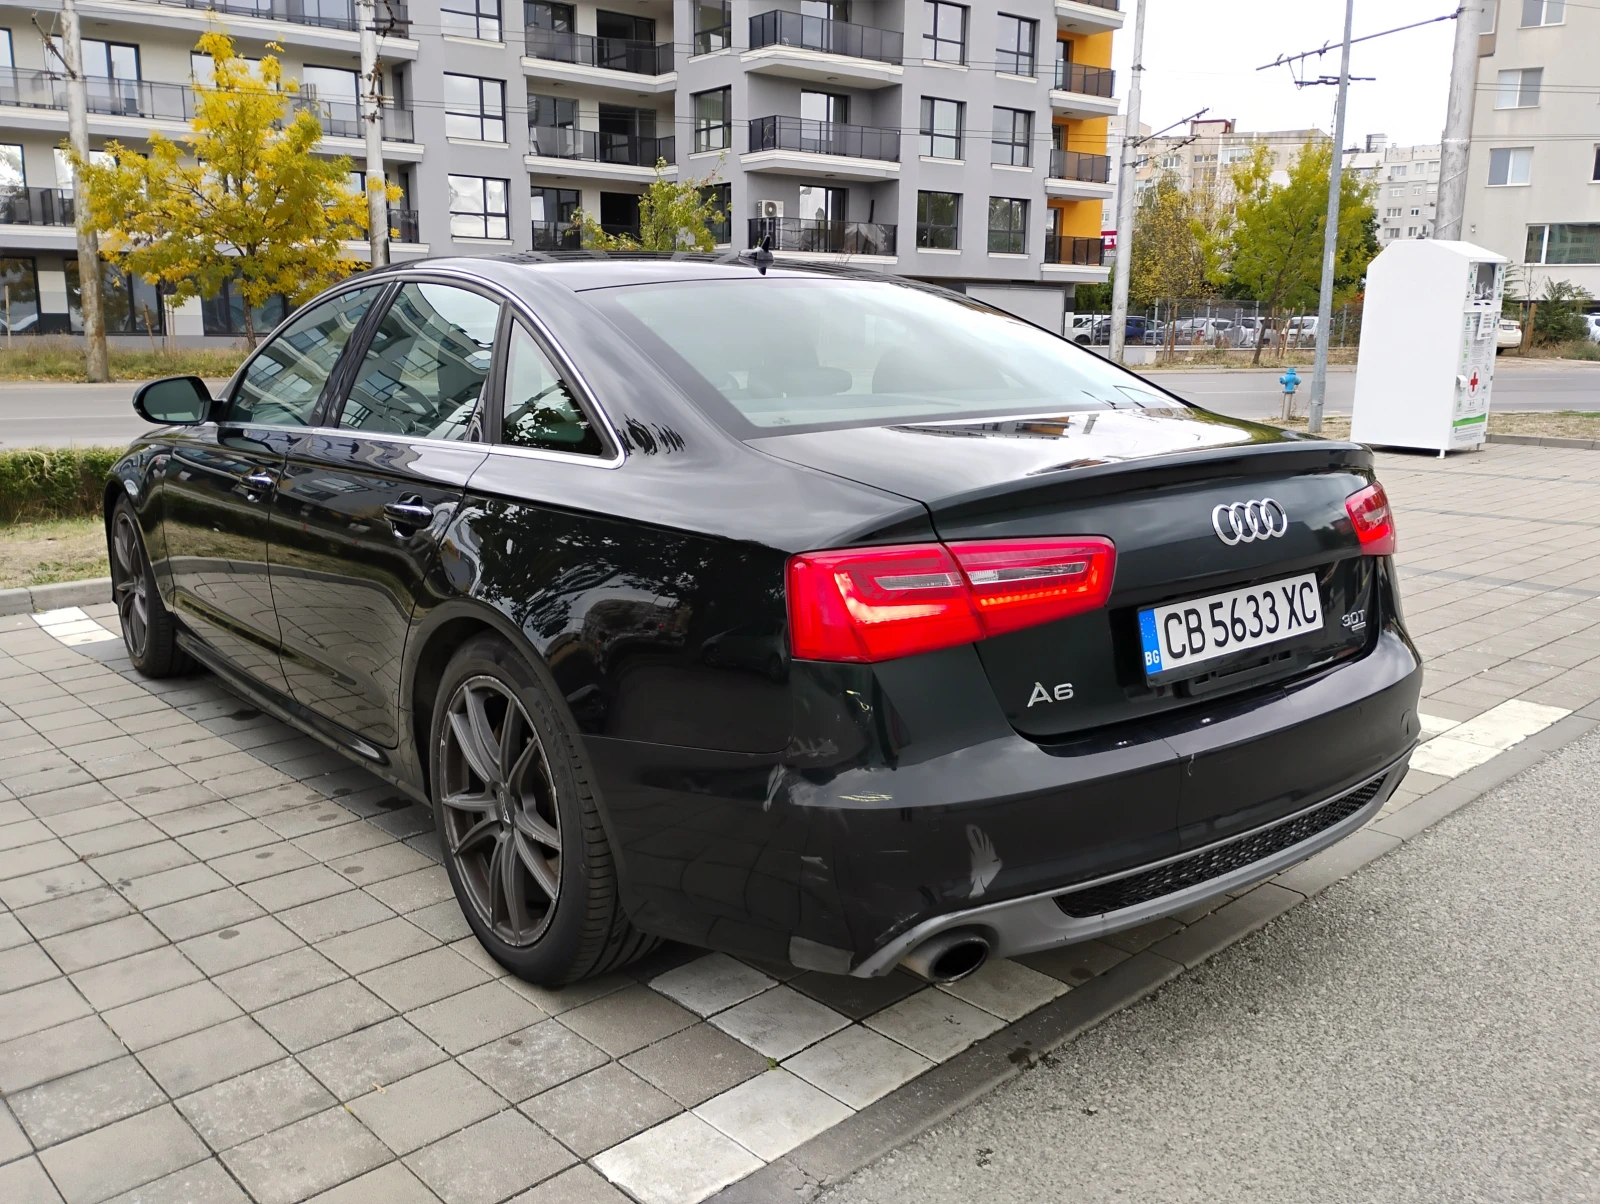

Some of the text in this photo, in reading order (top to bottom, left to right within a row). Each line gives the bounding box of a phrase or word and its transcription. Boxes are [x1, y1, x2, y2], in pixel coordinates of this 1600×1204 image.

[1101, 235, 1117, 245] ET
[1164, 582, 1317, 660] CB 5633 XC
[1144, 650, 1160, 666] BG
[1027, 682, 1074, 707] A6
